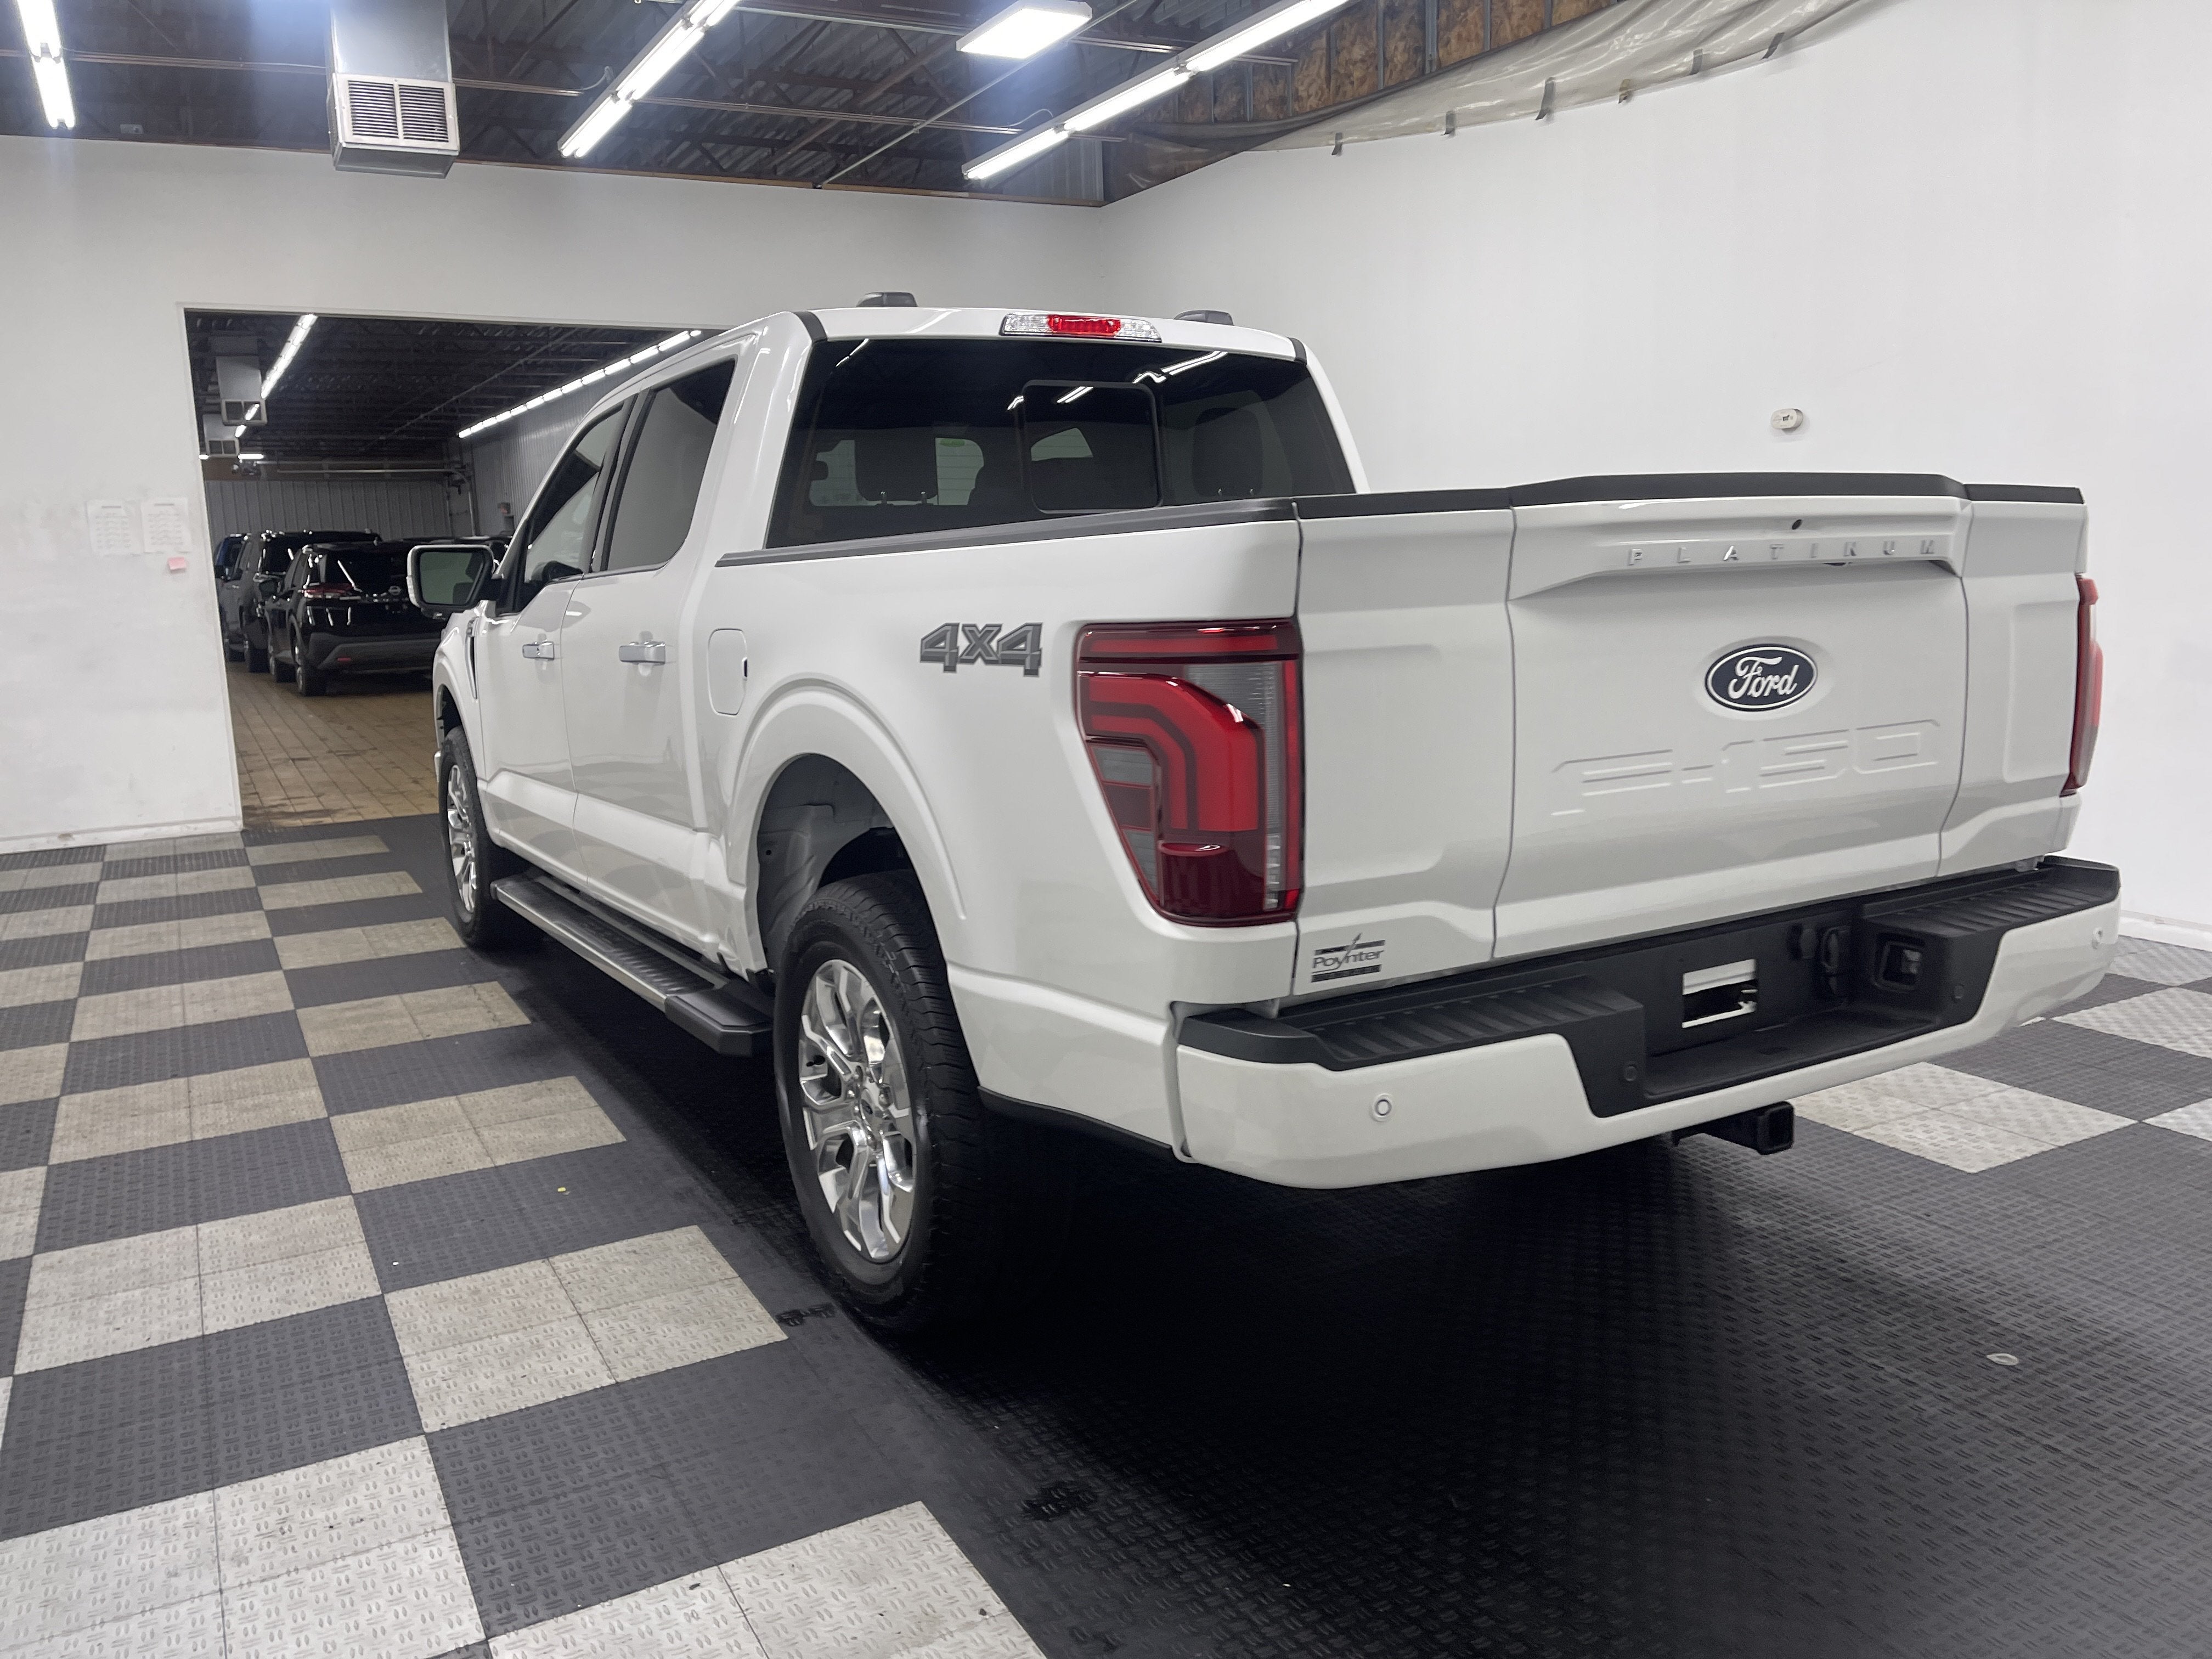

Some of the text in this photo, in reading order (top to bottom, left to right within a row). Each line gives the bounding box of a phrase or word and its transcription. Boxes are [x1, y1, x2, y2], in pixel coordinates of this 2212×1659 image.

[1628, 539, 1935, 565] PLATINUM
[1728, 656, 1799, 699] Ford
[1551, 719, 1939, 815] F-150
[1312, 933, 1384, 974] Poynter
